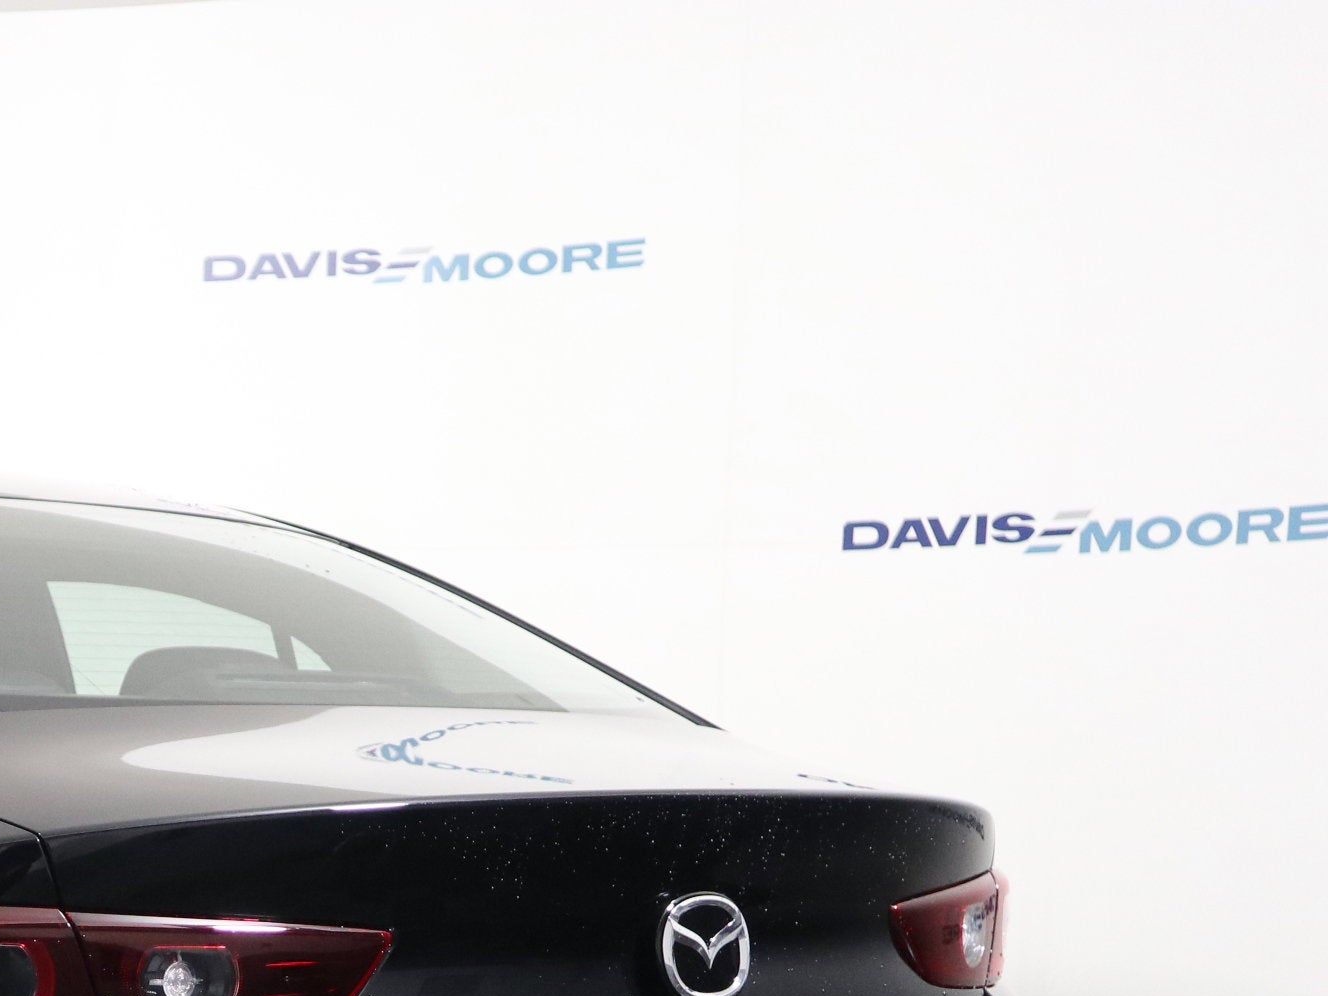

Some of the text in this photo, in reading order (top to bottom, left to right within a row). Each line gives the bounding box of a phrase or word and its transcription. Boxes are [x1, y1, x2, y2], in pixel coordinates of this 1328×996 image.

[203, 237, 648, 284] DAVIS MOORE
[841, 511, 1036, 551] DAVIS
